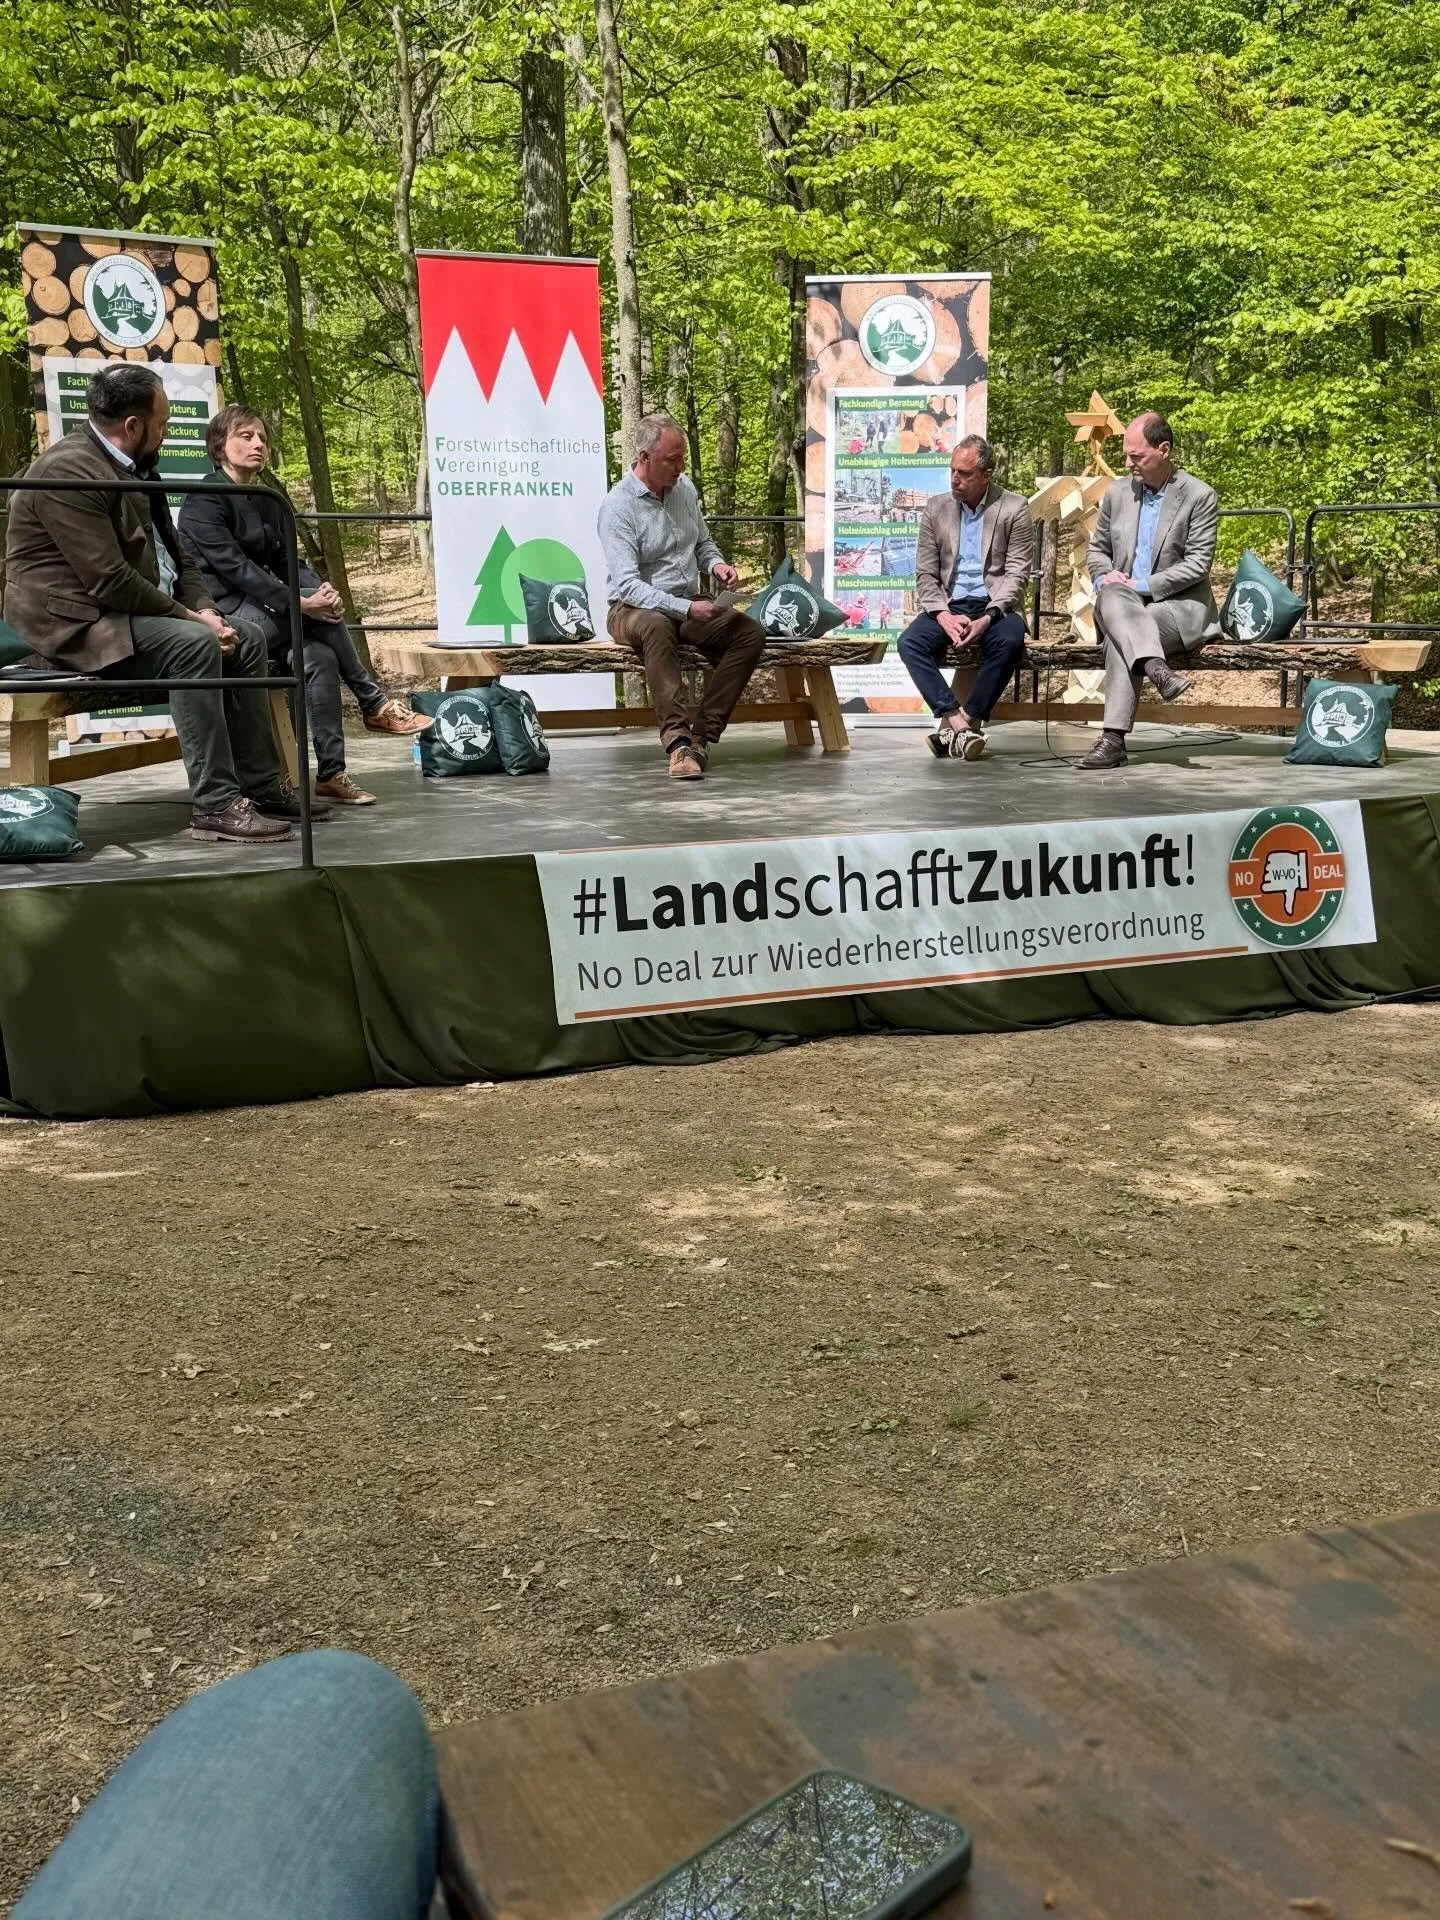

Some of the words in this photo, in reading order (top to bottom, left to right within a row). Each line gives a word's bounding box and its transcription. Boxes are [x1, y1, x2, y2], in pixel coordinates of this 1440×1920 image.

[69, 400, 89, 410] Una
[169, 404, 197, 416] rktung
[839, 399, 887, 409] Fachkundige
[889, 398, 925, 408] Beratung
[168, 426, 199, 439] rückung
[159, 447, 208, 458] formations-
[435, 436, 601, 454] Forstwirtschaftliche
[435, 457, 541, 477] Vereinigung
[838, 456, 889, 467] Unabhängige
[437, 481, 573, 497] OBERFRANKEN
[167, 495, 182, 504] tter
[892, 525, 907, 535] und
[908, 525, 920, 535] Ho
[1235, 871, 1254, 887] NO
[1313, 863, 1344, 880] DEAL
[1272, 867, 1296, 881] W-VO
[573, 833, 1195, 936] #LandschafftZukunft!
[578, 960, 622, 991] No
[634, 950, 702, 986] Deal
[711, 952, 759, 978] zur
[767, 911, 1205, 973] Wiederherstellungsverordnung
